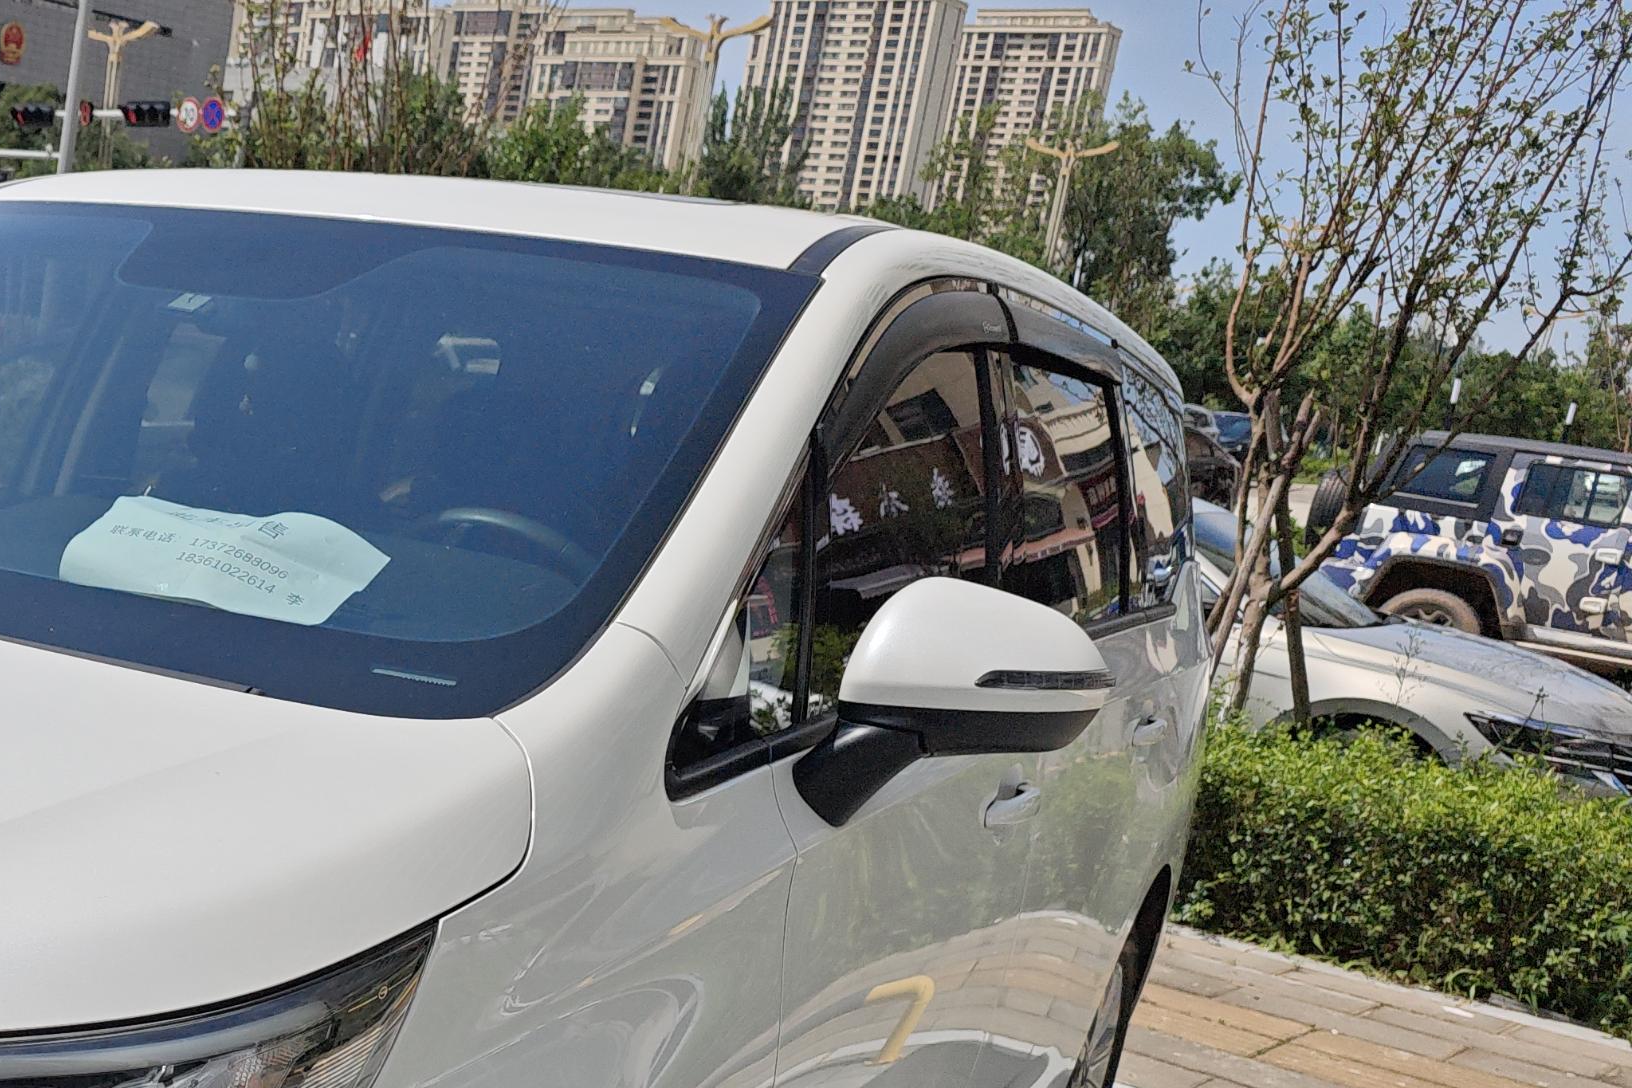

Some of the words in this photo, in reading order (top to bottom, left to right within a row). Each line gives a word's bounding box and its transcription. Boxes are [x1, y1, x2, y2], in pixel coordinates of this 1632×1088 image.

[176, 551, 276, 594] 18361022614
[286, 591, 305, 607] 李
[188, 537, 289, 579] 17372688096
